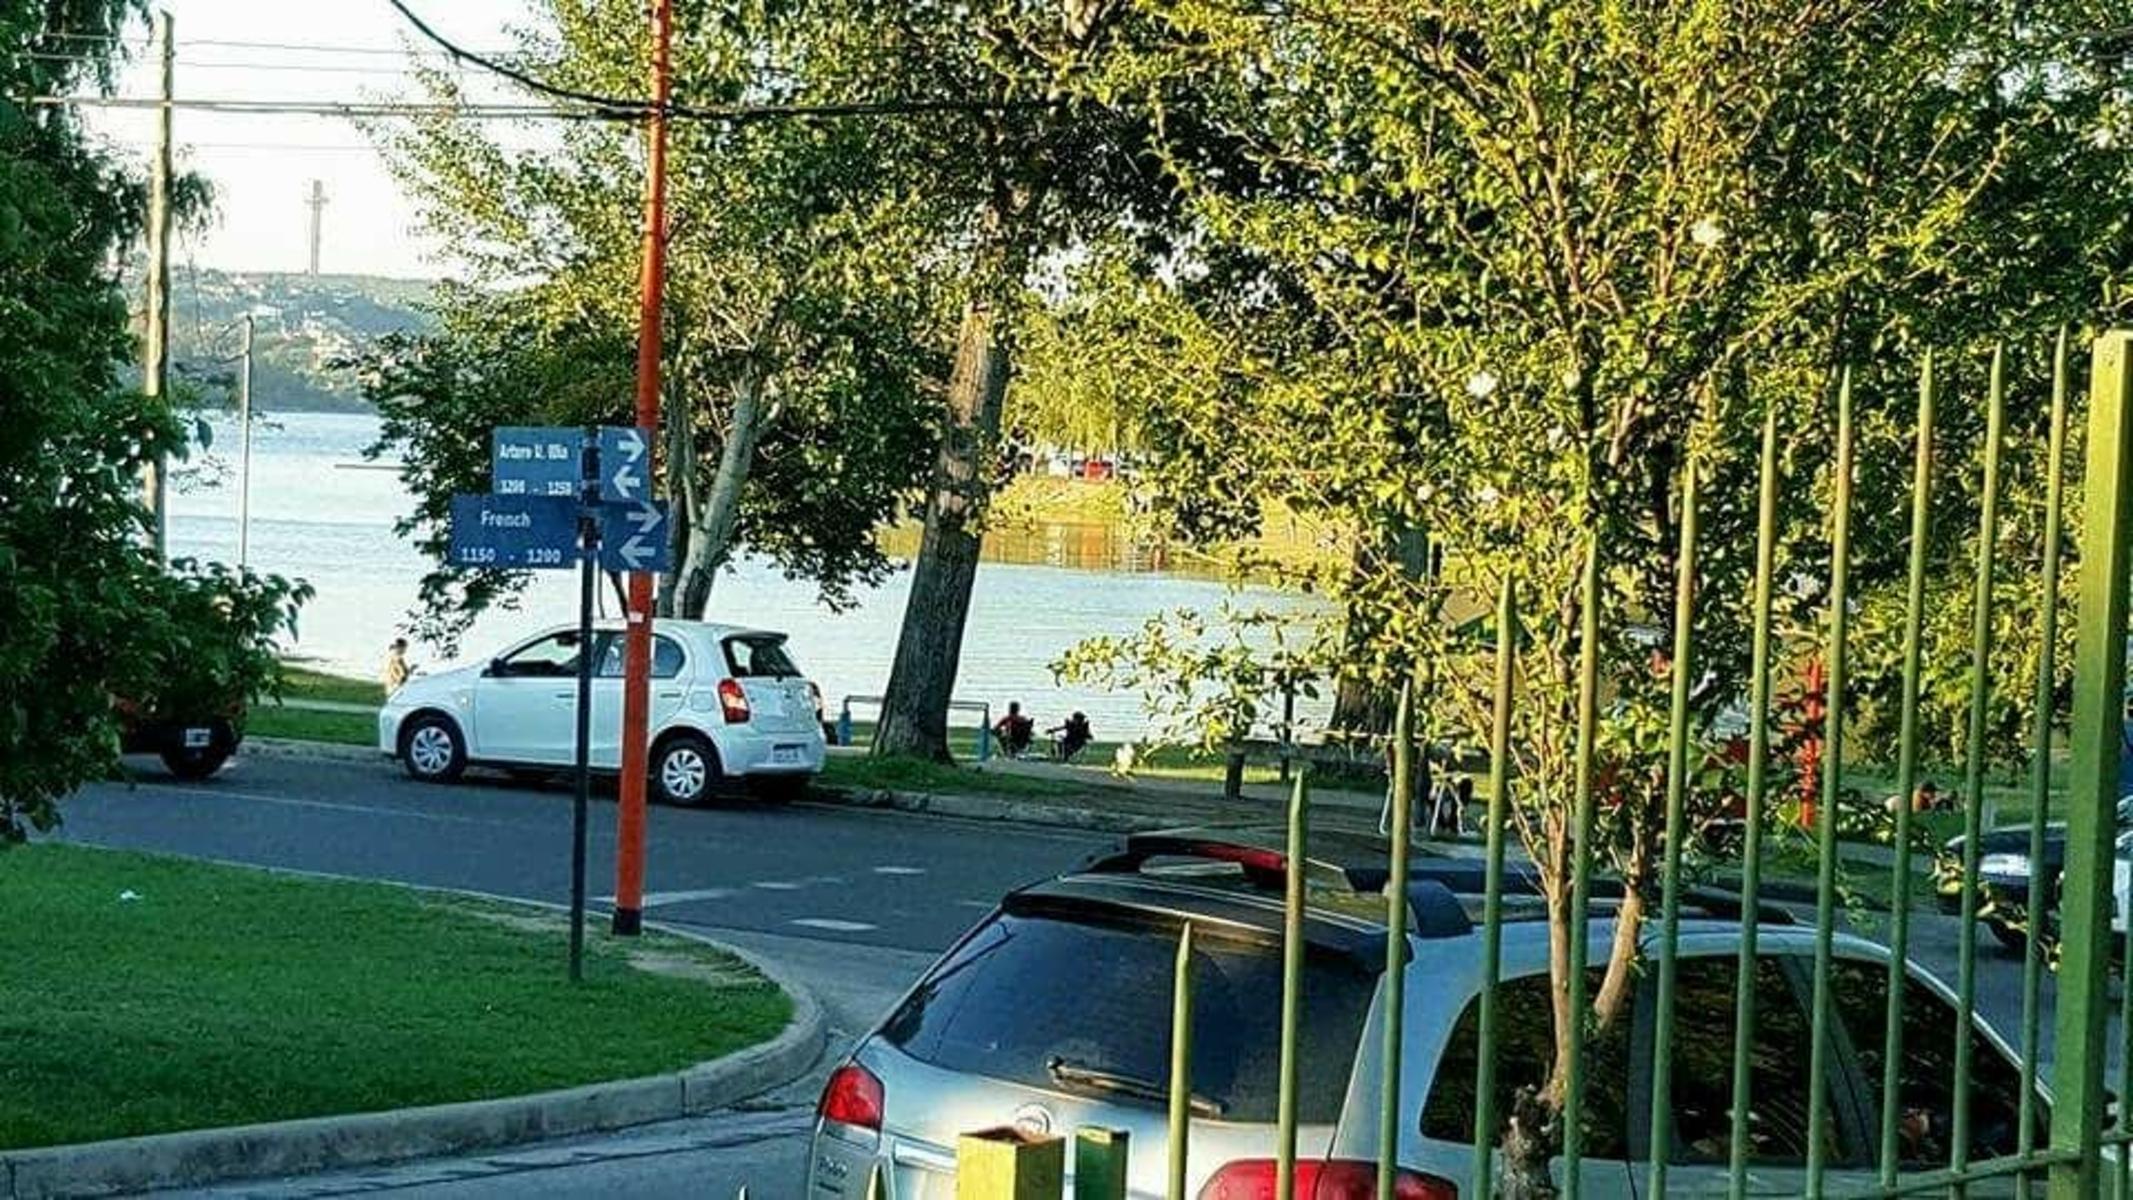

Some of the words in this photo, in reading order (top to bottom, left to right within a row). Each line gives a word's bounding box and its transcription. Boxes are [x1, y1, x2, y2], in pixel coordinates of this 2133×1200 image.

[481, 510, 531, 527] French
[462, 548, 496, 562] 1150
[527, 548, 561, 563] 1200
